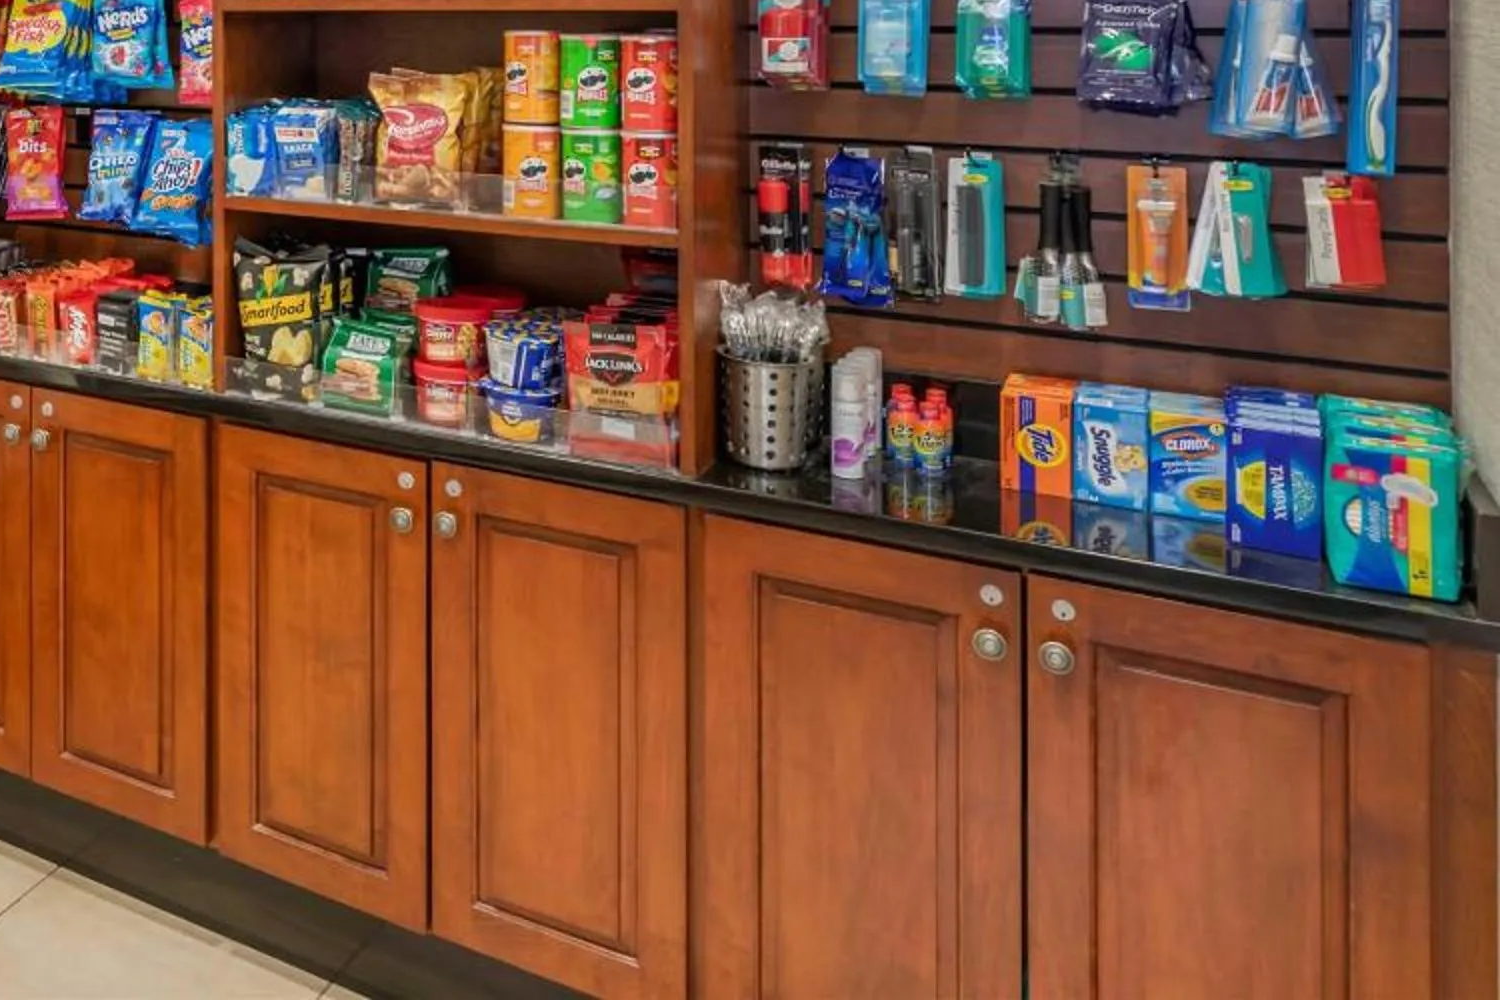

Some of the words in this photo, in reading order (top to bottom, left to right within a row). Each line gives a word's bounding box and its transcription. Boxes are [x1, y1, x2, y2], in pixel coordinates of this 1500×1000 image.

[97, 5, 148, 33] Nerds
[761, 158, 797, 171] Gillette
[243, 300, 305, 322] Smartfood
[1026, 427, 1055, 464] Tide
[1090, 425, 1116, 487] Snuggle
[1268, 464, 1288, 522] TAMPAX
